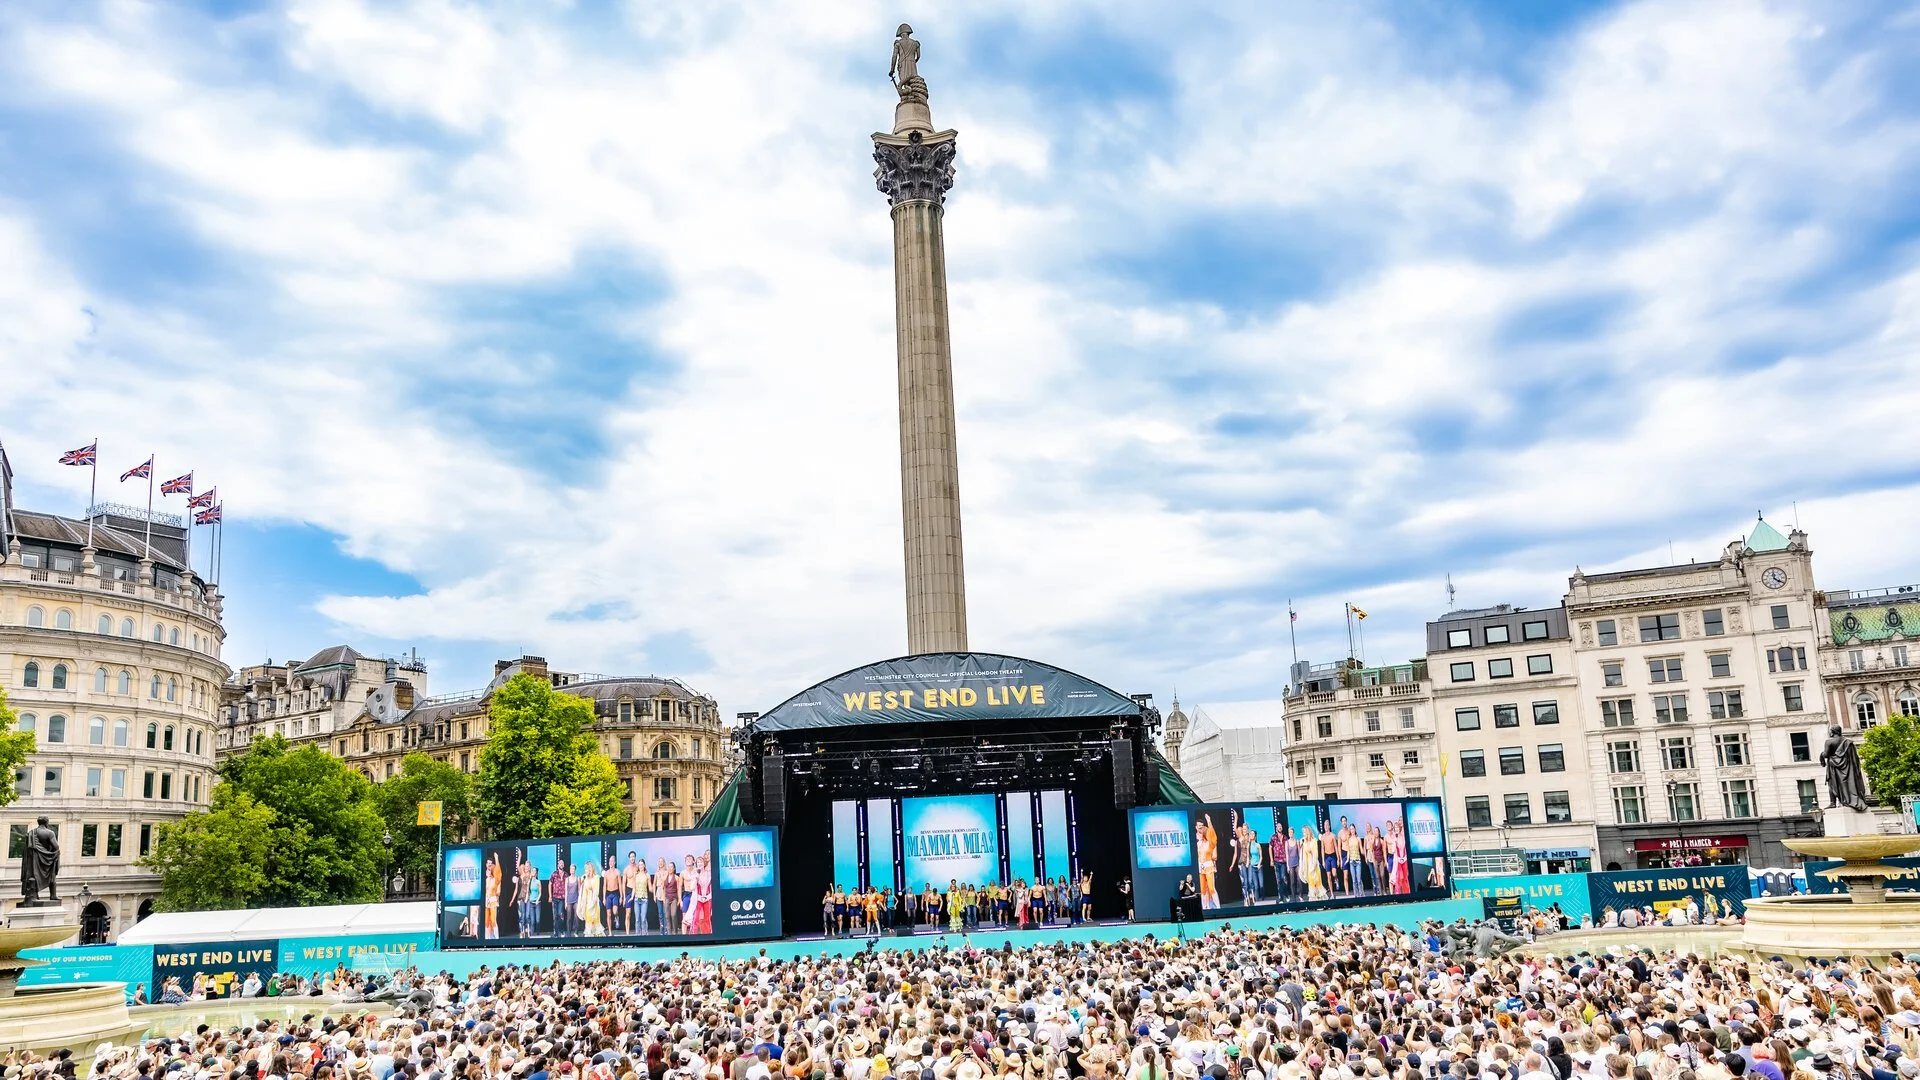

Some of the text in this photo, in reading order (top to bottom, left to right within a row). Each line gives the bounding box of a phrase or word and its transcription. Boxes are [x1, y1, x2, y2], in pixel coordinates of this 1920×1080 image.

[1591, 574, 1720, 597] CANADIAN PACIFIC
[843, 684, 1046, 712] WEST END LIVE
[907, 830, 994, 857] MAMMA MIA!
[1137, 831, 1188, 847] MAMMA MIA!
[1669, 838, 1712, 848] PRET A MANGER
[720, 852, 772, 868] MAMMA MIA!
[1551, 850, 1578, 858] NERO
[1451, 884, 1563, 899] WEST END LIVE
[1613, 875, 1726, 893] WEST END LIVE
[156, 953, 197, 967] WEST
[201, 951, 233, 965] END
[237, 949, 272, 963] LIVE
[303, 946, 343, 960] WEST
